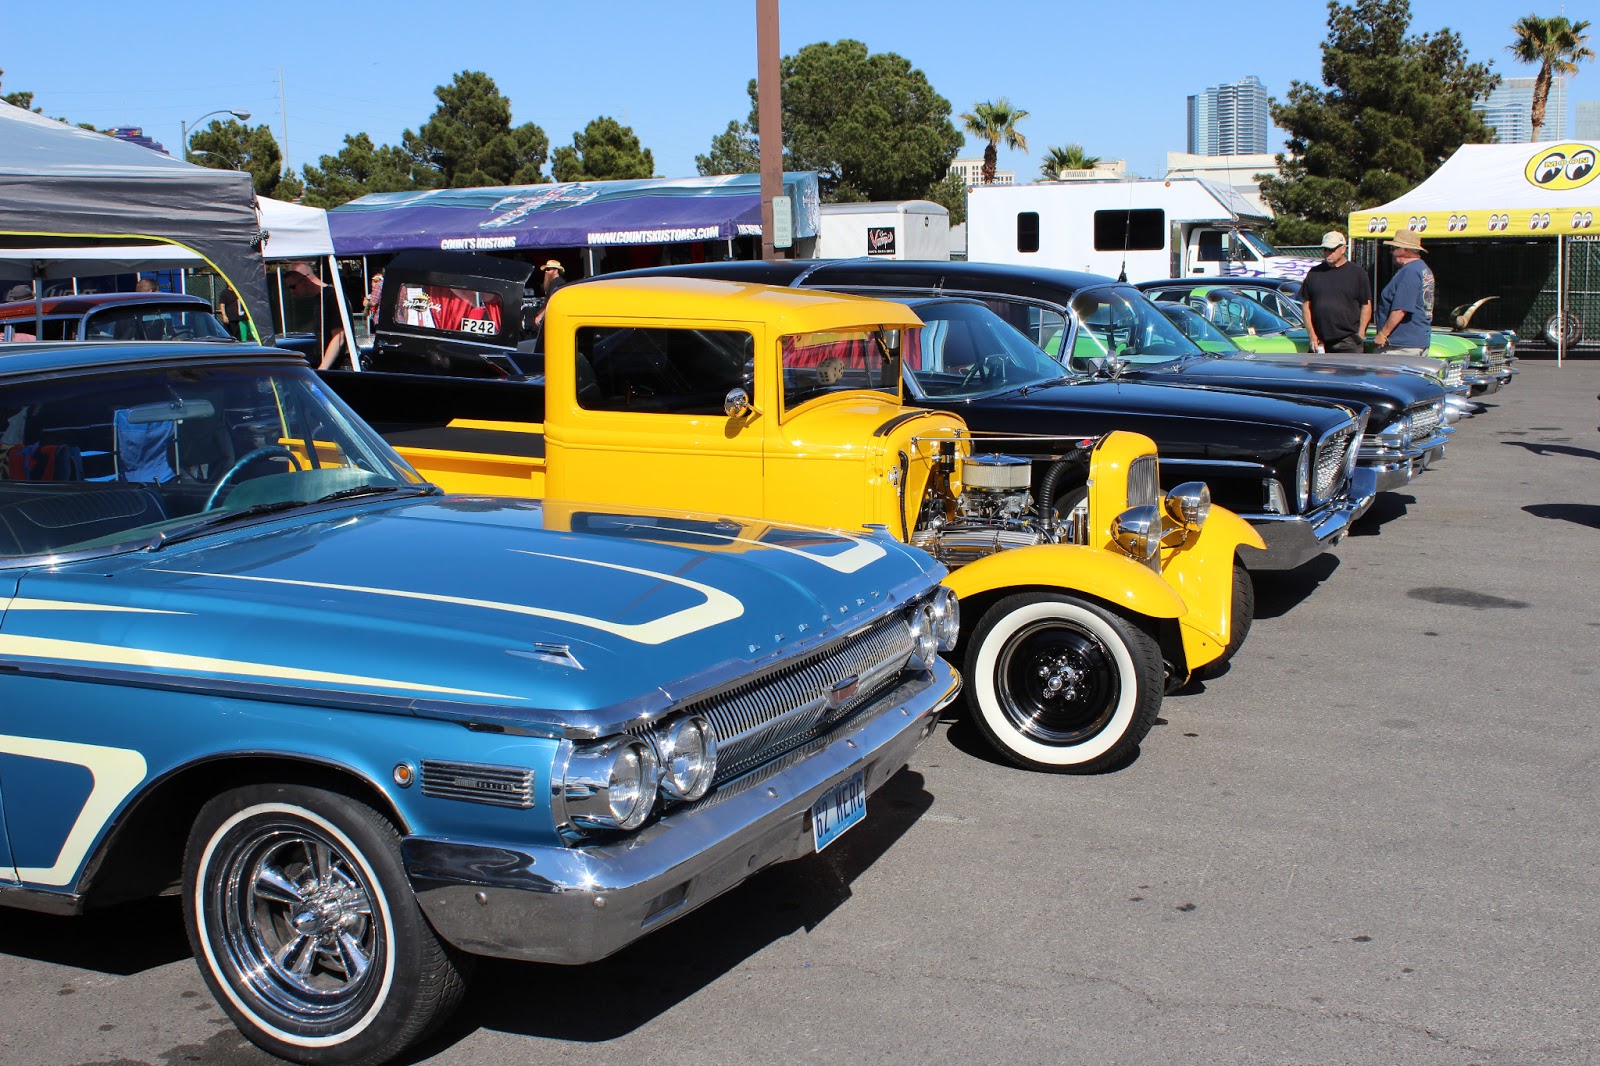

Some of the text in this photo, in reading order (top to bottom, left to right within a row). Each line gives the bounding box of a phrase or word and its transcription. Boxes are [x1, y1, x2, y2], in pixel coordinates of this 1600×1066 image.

[1544, 157, 1589, 168] MOON
[587, 226, 719, 244] WWW.COUNTSKUSTOMS.COM
[441, 237, 516, 250] COUNT'S KUSTOMS
[462, 319, 494, 333] F242
[815, 778, 864, 838] 62 MERC
